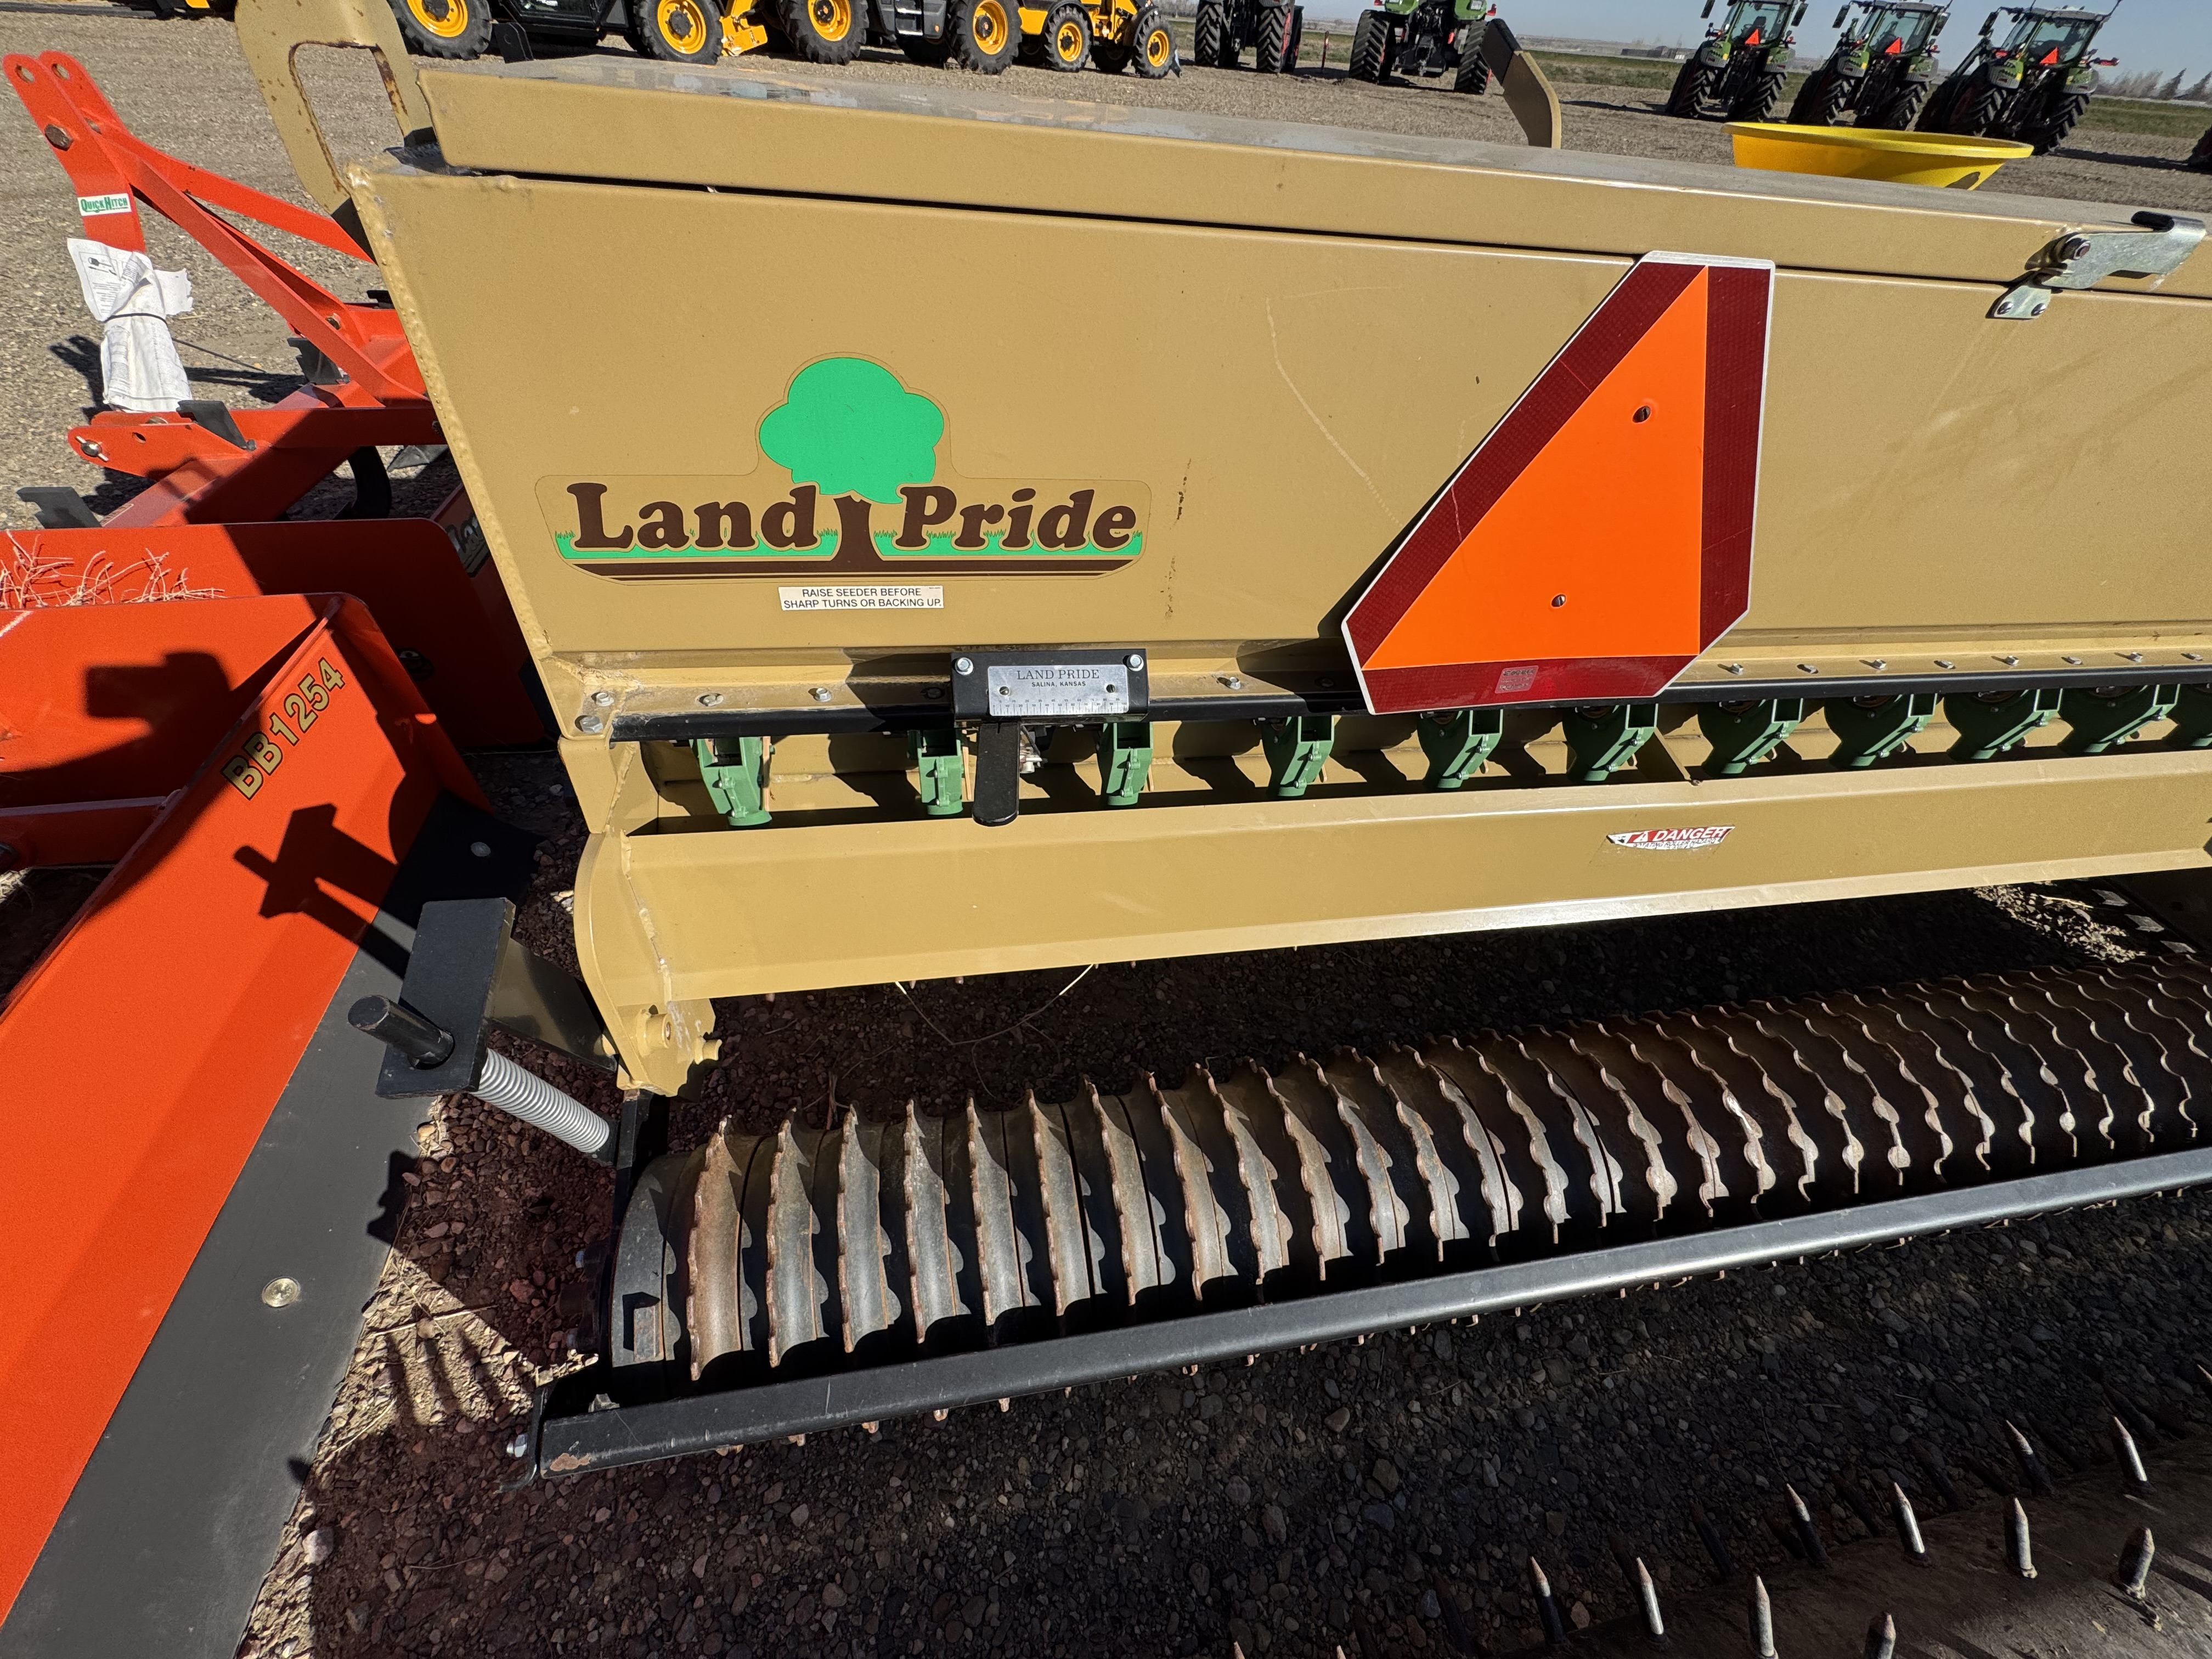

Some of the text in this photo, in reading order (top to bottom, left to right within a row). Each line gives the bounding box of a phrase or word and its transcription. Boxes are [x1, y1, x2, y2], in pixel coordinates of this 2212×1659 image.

[566, 482, 1136, 549] Land Pride
[802, 588, 922, 597] RAISE SEEDER BEFORE
[783, 600, 819, 608] SHARP
[823, 599, 857, 608] TURNS
[860, 599, 876, 607] OR
[879, 599, 924, 607] BACKING
[1017, 669, 1099, 680] LAND PRIDE
[221, 657, 346, 801] BB1254
[1652, 827, 1728, 842] DANGER
